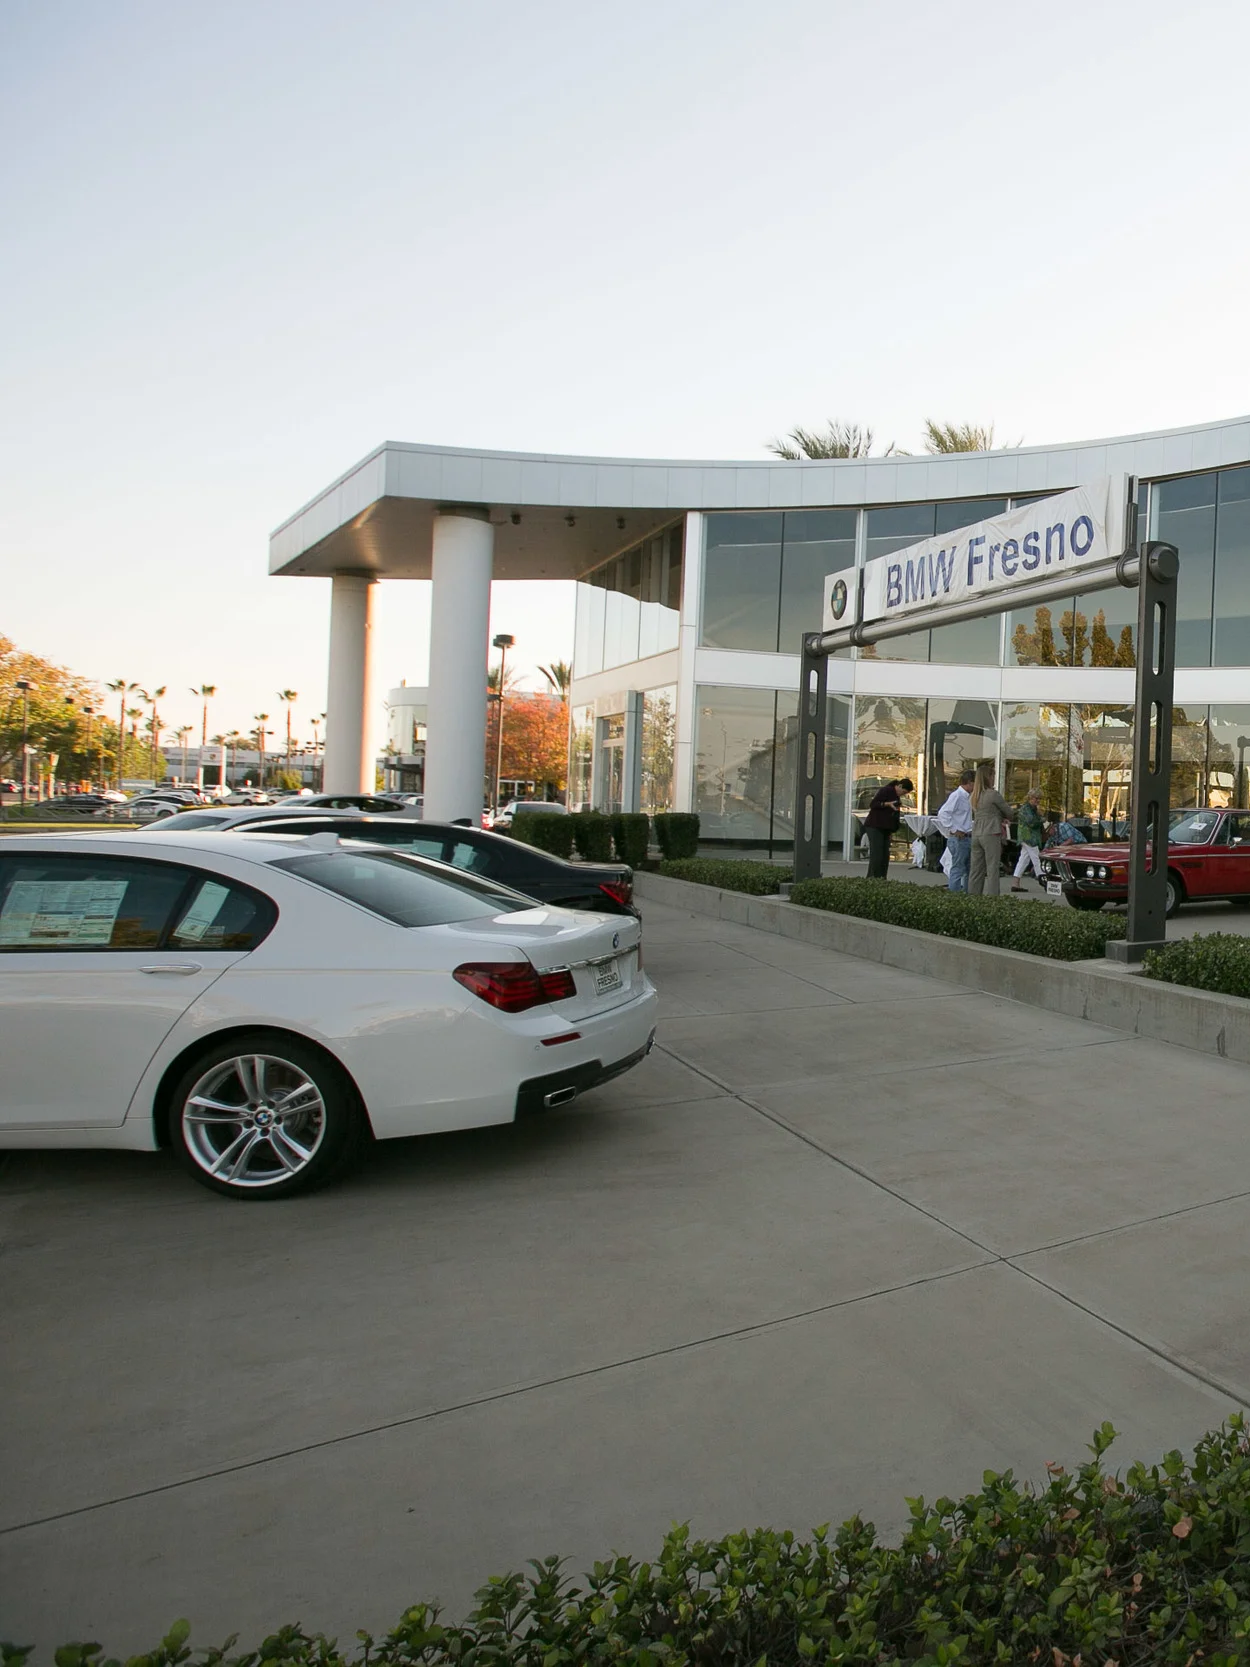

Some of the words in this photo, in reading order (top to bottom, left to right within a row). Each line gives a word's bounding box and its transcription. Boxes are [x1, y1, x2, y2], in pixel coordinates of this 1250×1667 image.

[887, 546, 957, 608] BMW
[966, 515, 1095, 586] Fresno
[597, 972, 618, 988] FRESNO
